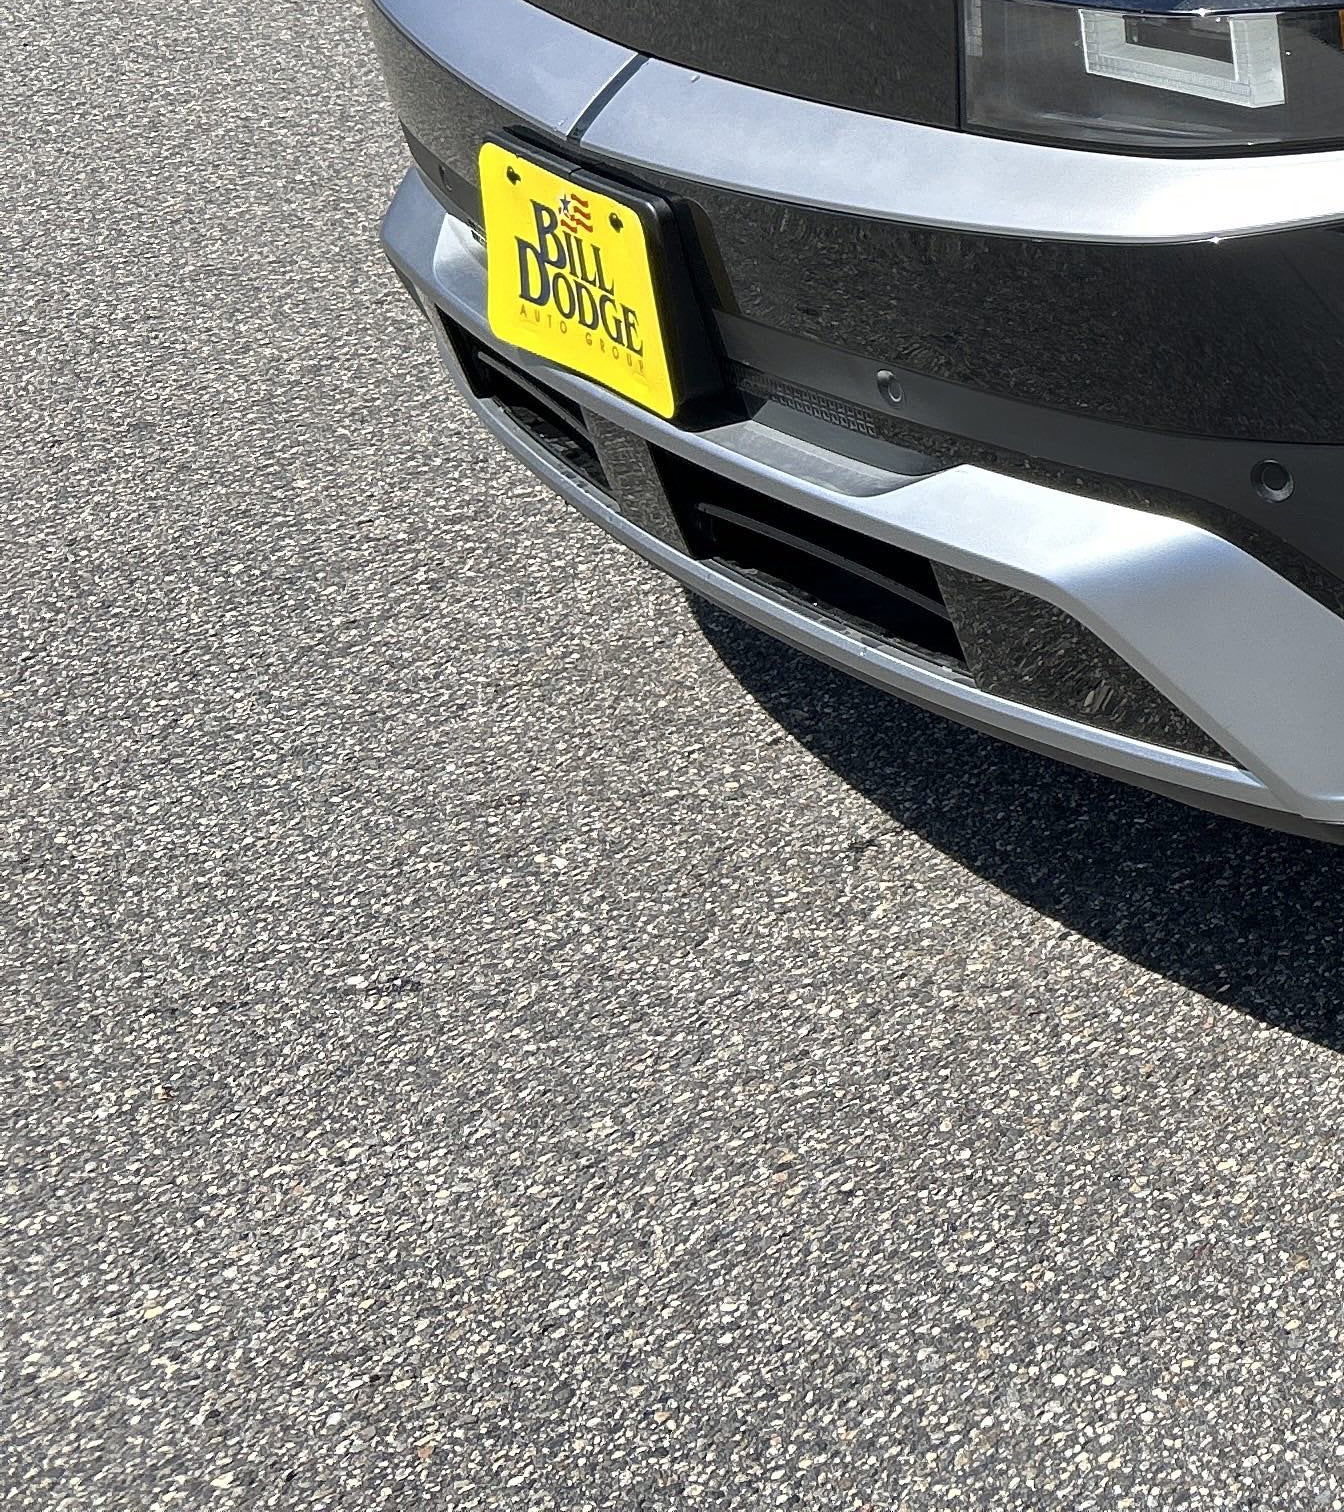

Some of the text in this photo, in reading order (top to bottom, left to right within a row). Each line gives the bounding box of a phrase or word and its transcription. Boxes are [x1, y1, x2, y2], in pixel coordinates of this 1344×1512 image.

[514, 235, 644, 357] DODGE
[529, 198, 615, 296] BILL
[520, 306, 646, 374] AUTO GROUP
